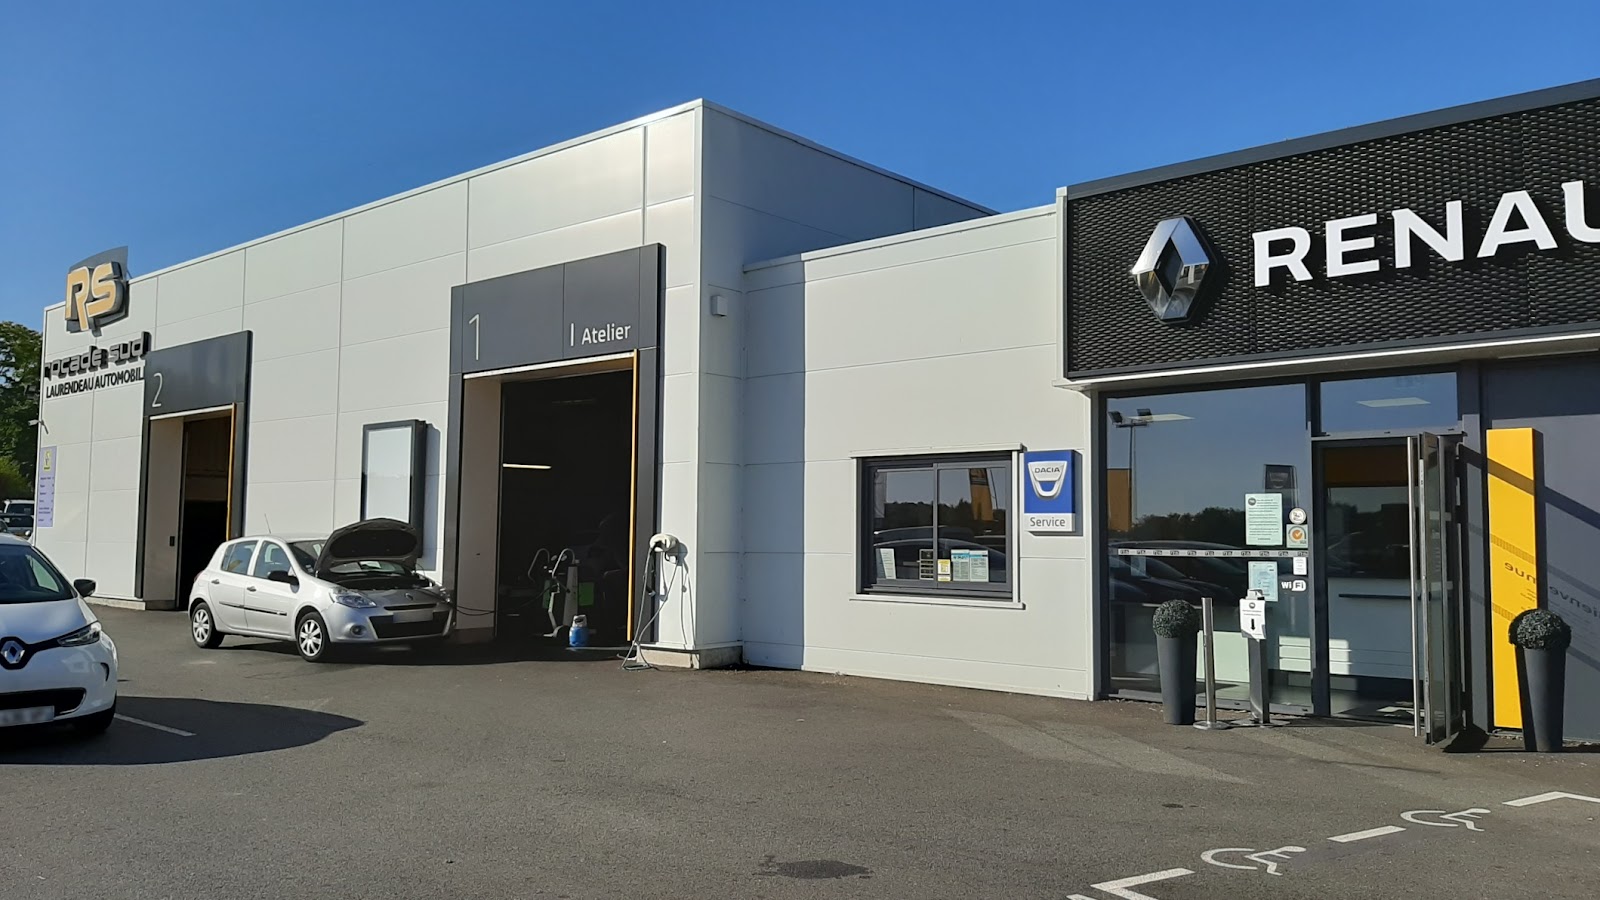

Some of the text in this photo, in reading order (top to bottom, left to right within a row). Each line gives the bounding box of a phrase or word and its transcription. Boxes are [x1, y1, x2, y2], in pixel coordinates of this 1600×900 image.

[65, 262, 122, 331] RS
[109, 331, 150, 365] sud
[469, 314, 480, 360] 1
[581, 323, 631, 345] Atelier
[46, 377, 94, 398] LAURENDEAU
[152, 373, 163, 408] 2
[1030, 517, 1065, 526] Service
